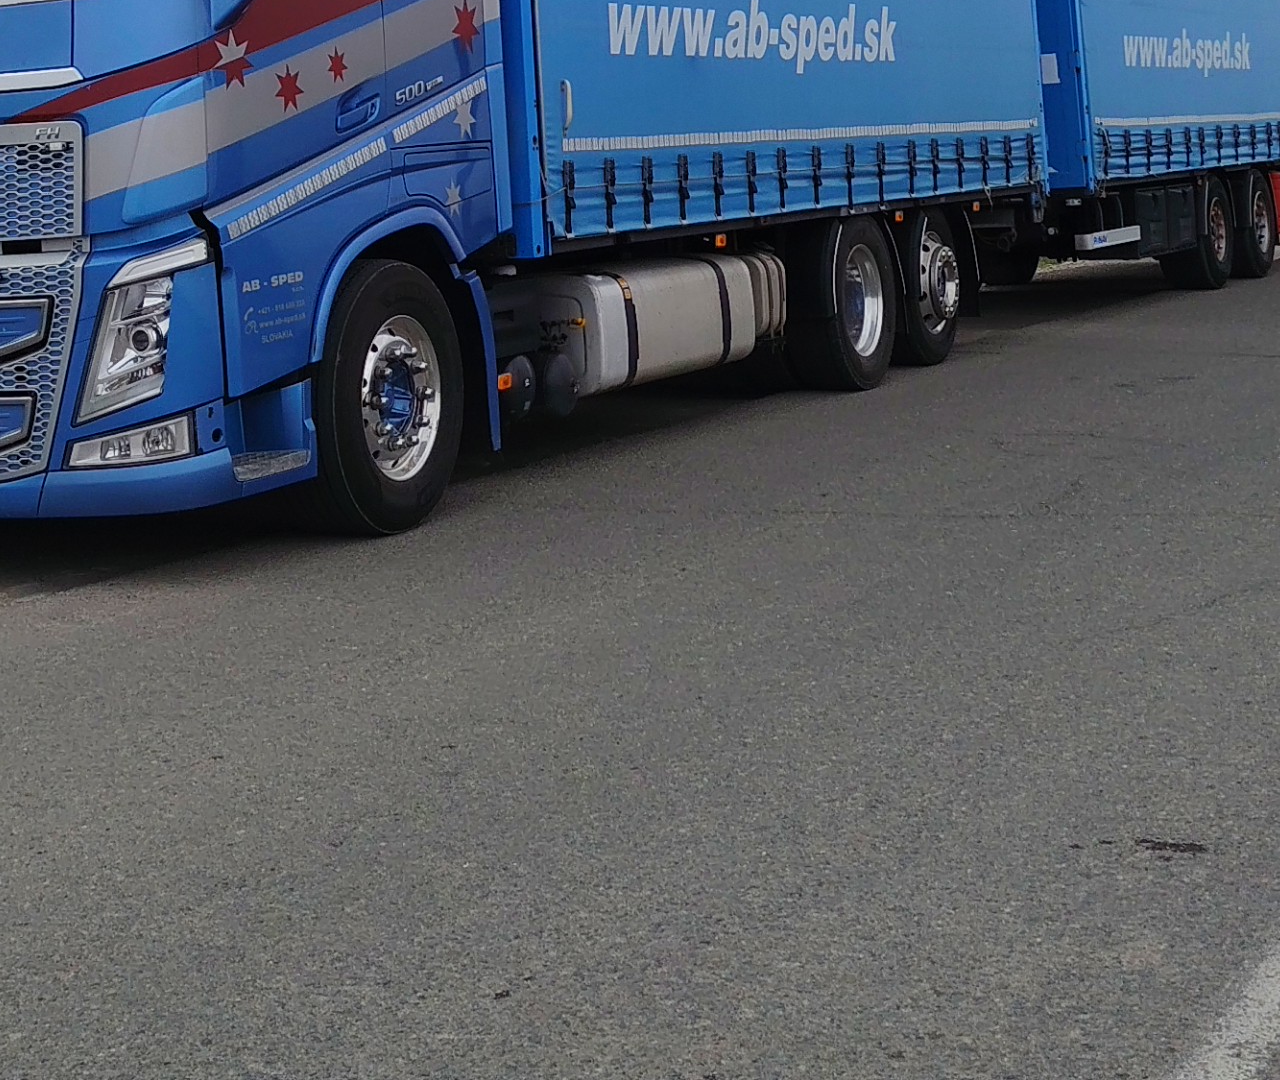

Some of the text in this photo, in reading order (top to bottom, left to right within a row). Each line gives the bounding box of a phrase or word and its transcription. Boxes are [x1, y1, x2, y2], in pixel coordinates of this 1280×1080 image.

[1123, 28, 1251, 77] www.ab-sped.sk
[395, 80, 424, 106] 500
[35, 126, 60, 140] FH
[242, 279, 260, 293] AB
[270, 271, 304, 287] SPED
